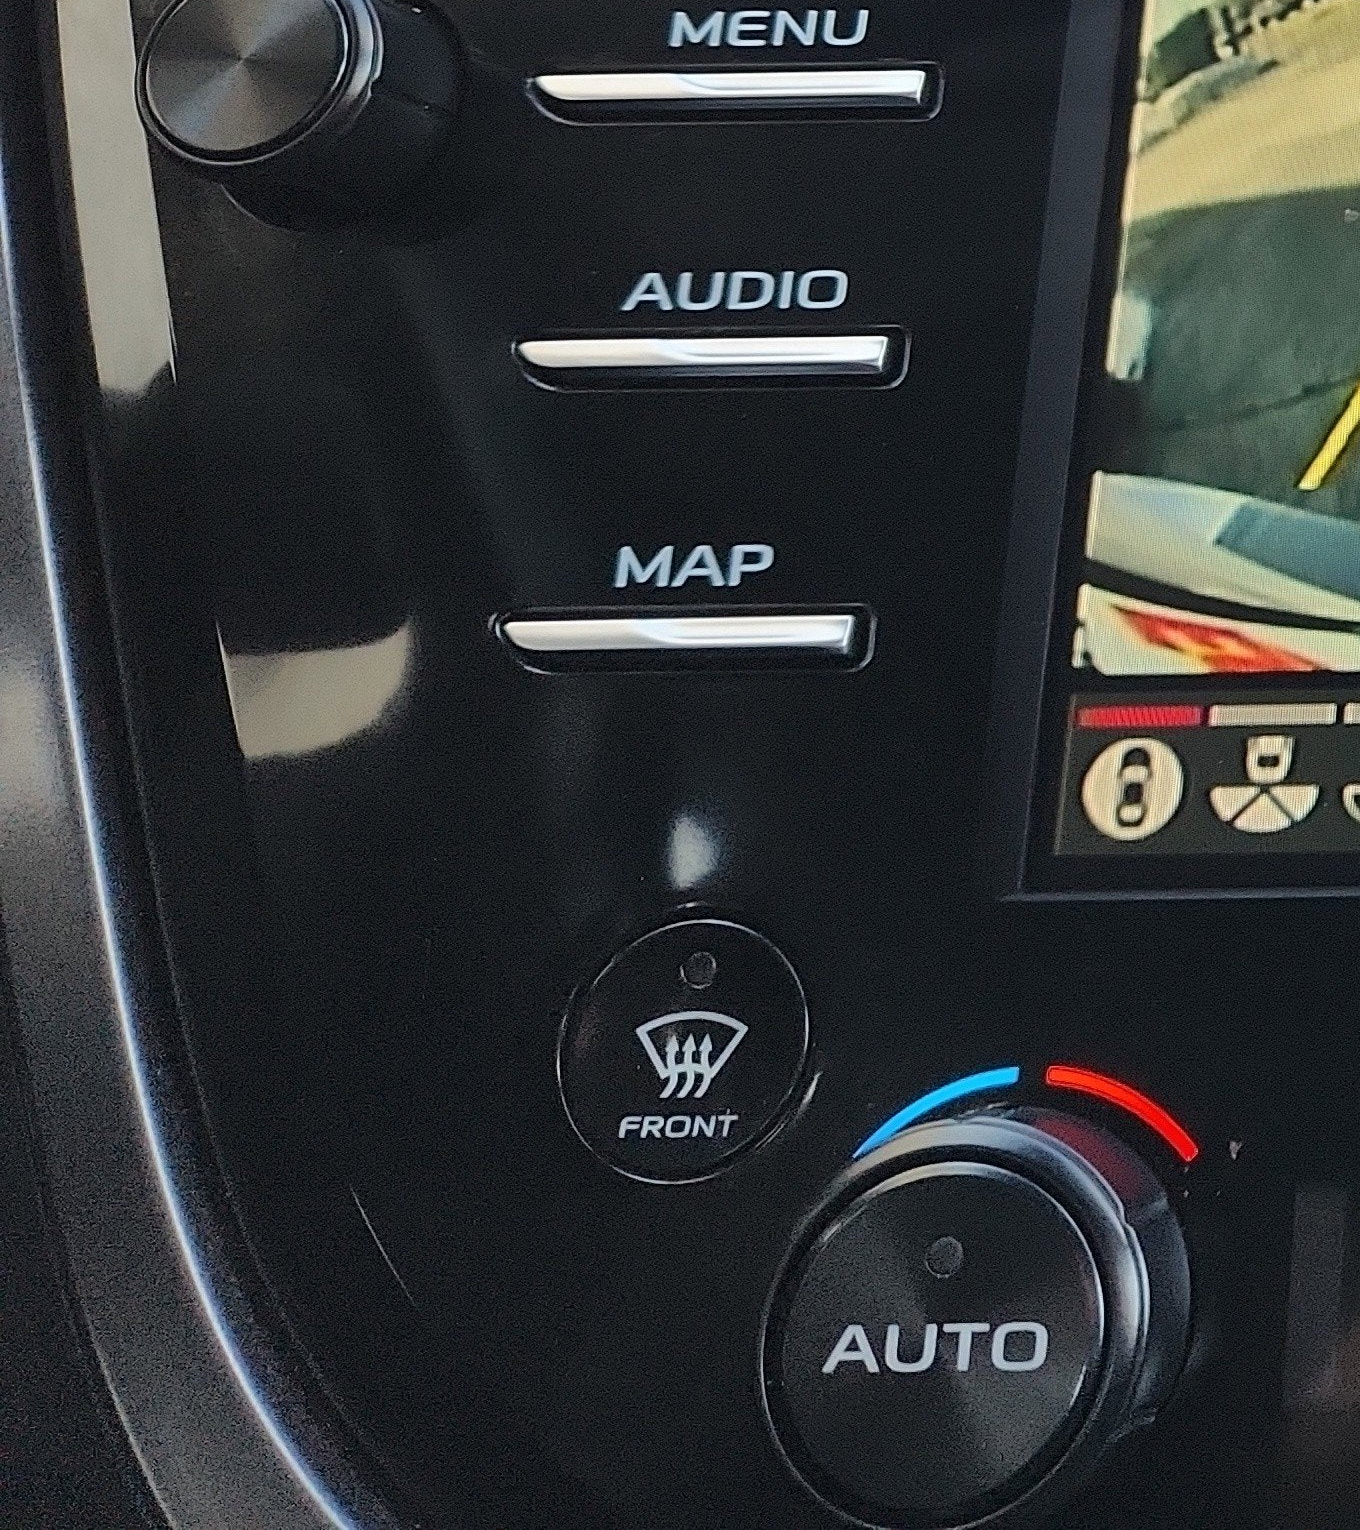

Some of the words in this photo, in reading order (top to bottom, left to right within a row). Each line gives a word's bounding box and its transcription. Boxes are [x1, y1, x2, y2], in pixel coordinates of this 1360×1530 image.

[668, 9, 870, 48] MENU
[620, 270, 849, 311] AUDIO
[613, 543, 775, 588] MAP
[618, 1113, 739, 1139] FRONT
[822, 1321, 1049, 1374] AUTO
